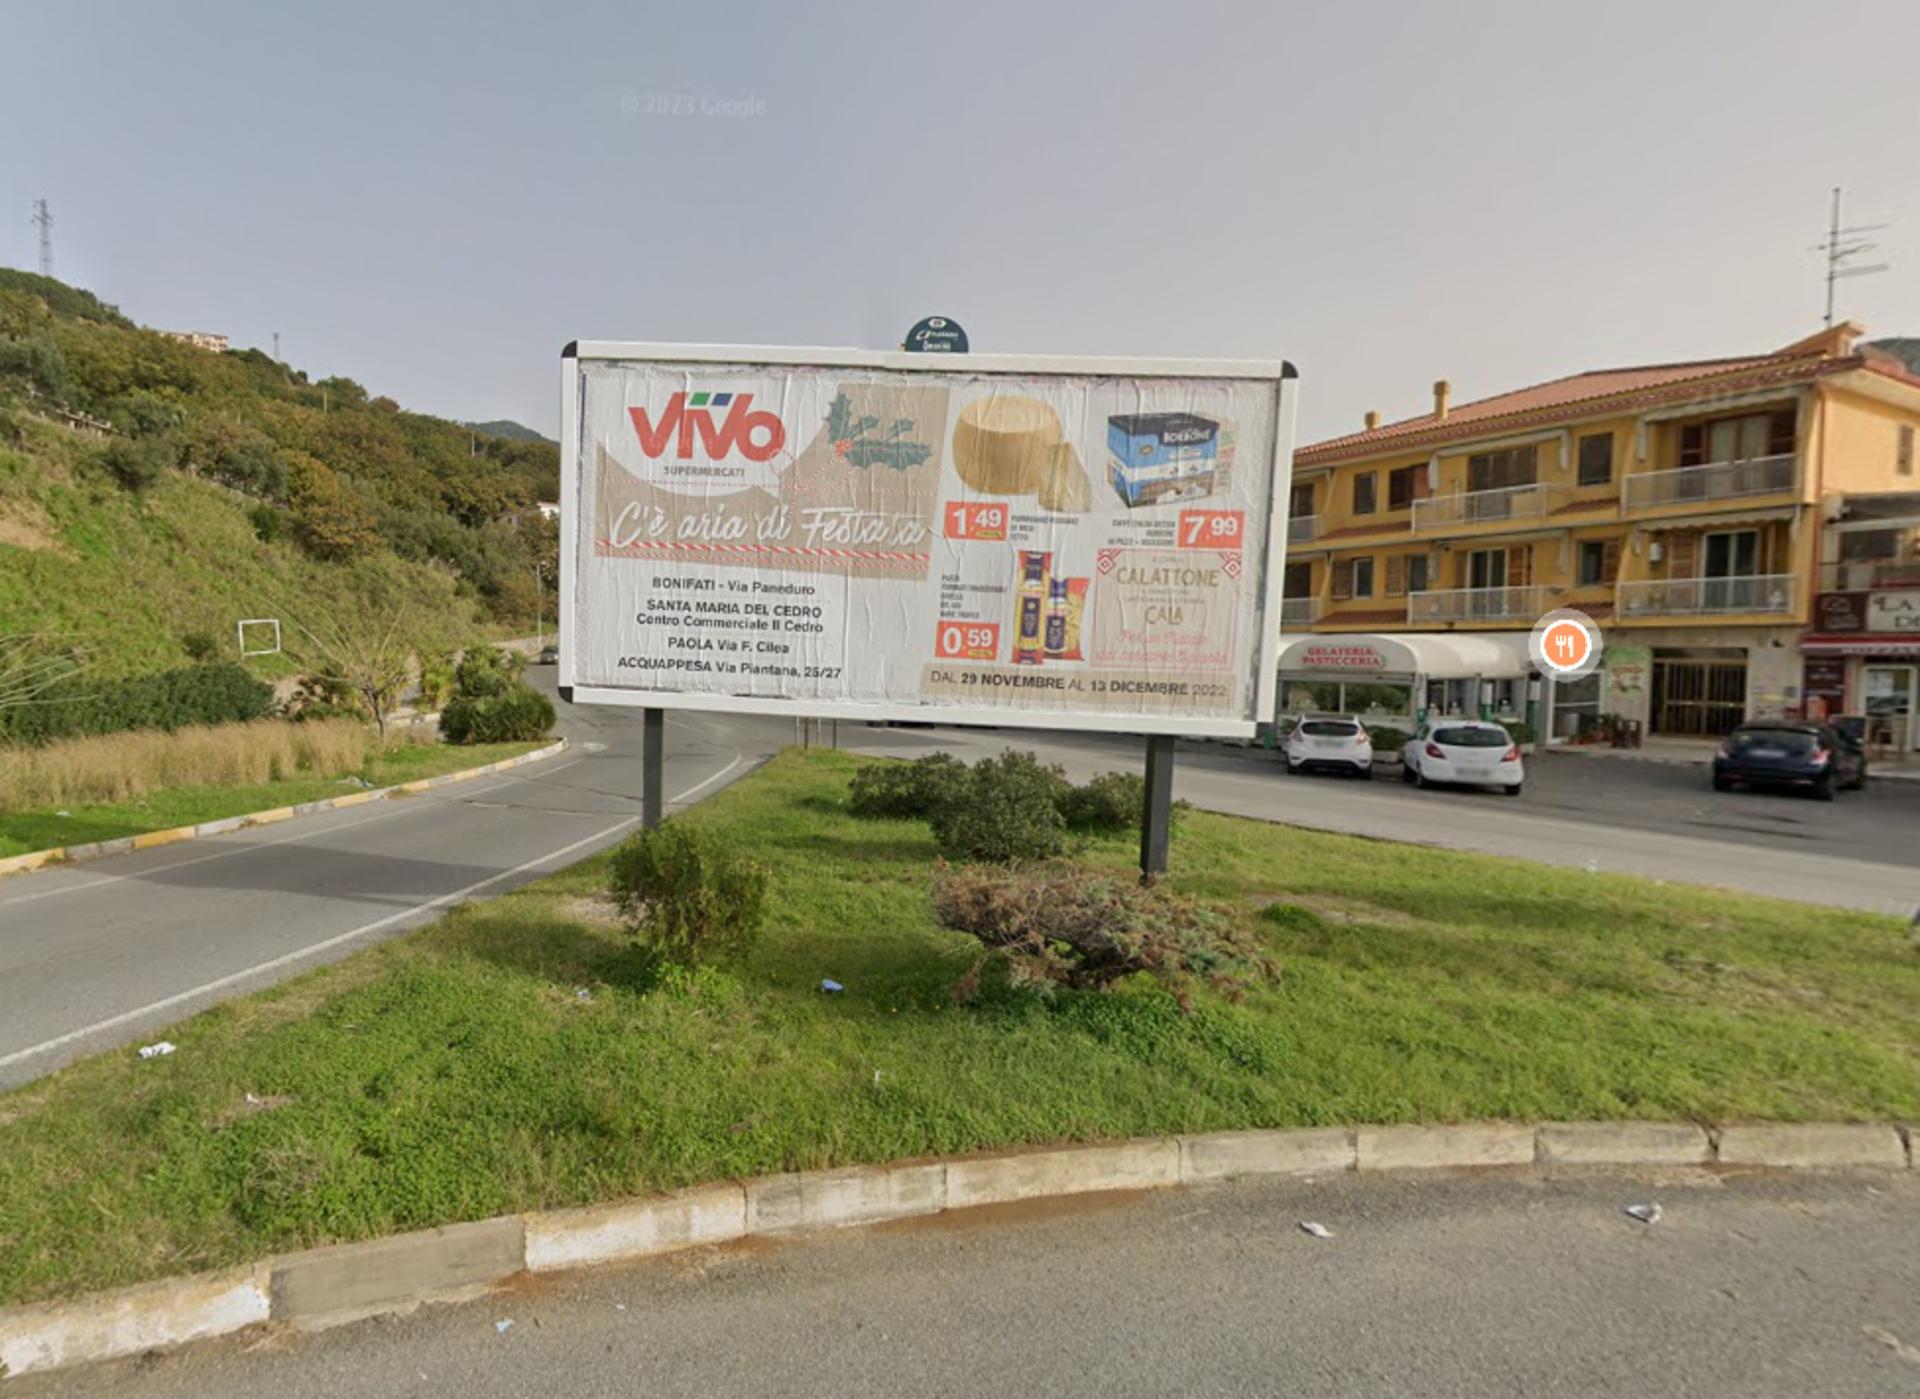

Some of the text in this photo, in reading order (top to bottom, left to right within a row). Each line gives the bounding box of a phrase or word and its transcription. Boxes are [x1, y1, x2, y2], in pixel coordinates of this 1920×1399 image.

[663, 465, 745, 477] SUPERMERCATI
[677, 504, 749, 540] aria
[756, 505, 791, 541] di
[1116, 561, 1220, 587] CALATTONE
[652, 576, 716, 590] BONIFATI
[727, 580, 748, 592] Via
[752, 581, 816, 595] Paneduro
[646, 599, 823, 619] SANTA MARIA DEL CEDRO
[636, 612, 680, 626] Centro
[684, 615, 769, 631] Commerciale
[784, 620, 824, 633] Cedro
[667, 637, 714, 650] PAOLA
[717, 639, 738, 651] Via
[617, 657, 713, 672] ACQUAPPESA
[716, 660, 737, 673] Via
[804, 666, 843, 679] 25/27
[931, 670, 1228, 697] DAL 29 NOVEMBRE AL 13 DICEMBRE 2022
